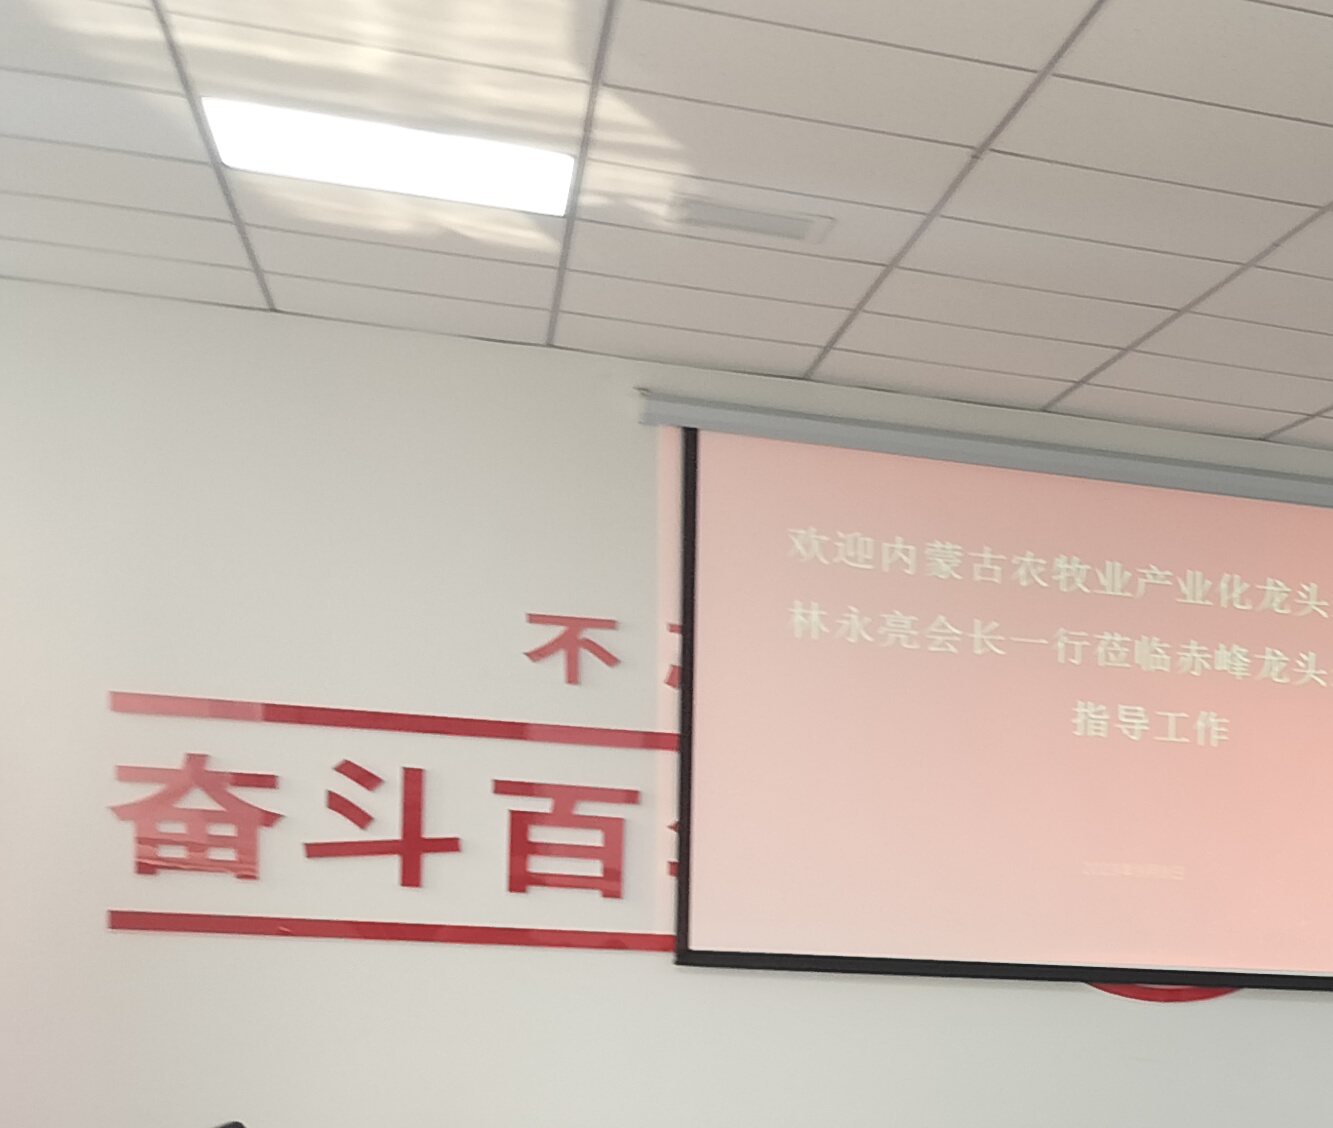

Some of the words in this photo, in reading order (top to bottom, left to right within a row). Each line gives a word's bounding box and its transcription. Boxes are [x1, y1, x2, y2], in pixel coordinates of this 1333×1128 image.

[1072, 700, 1231, 748] 指导工作
[108, 753, 679, 900] 奋斗百
